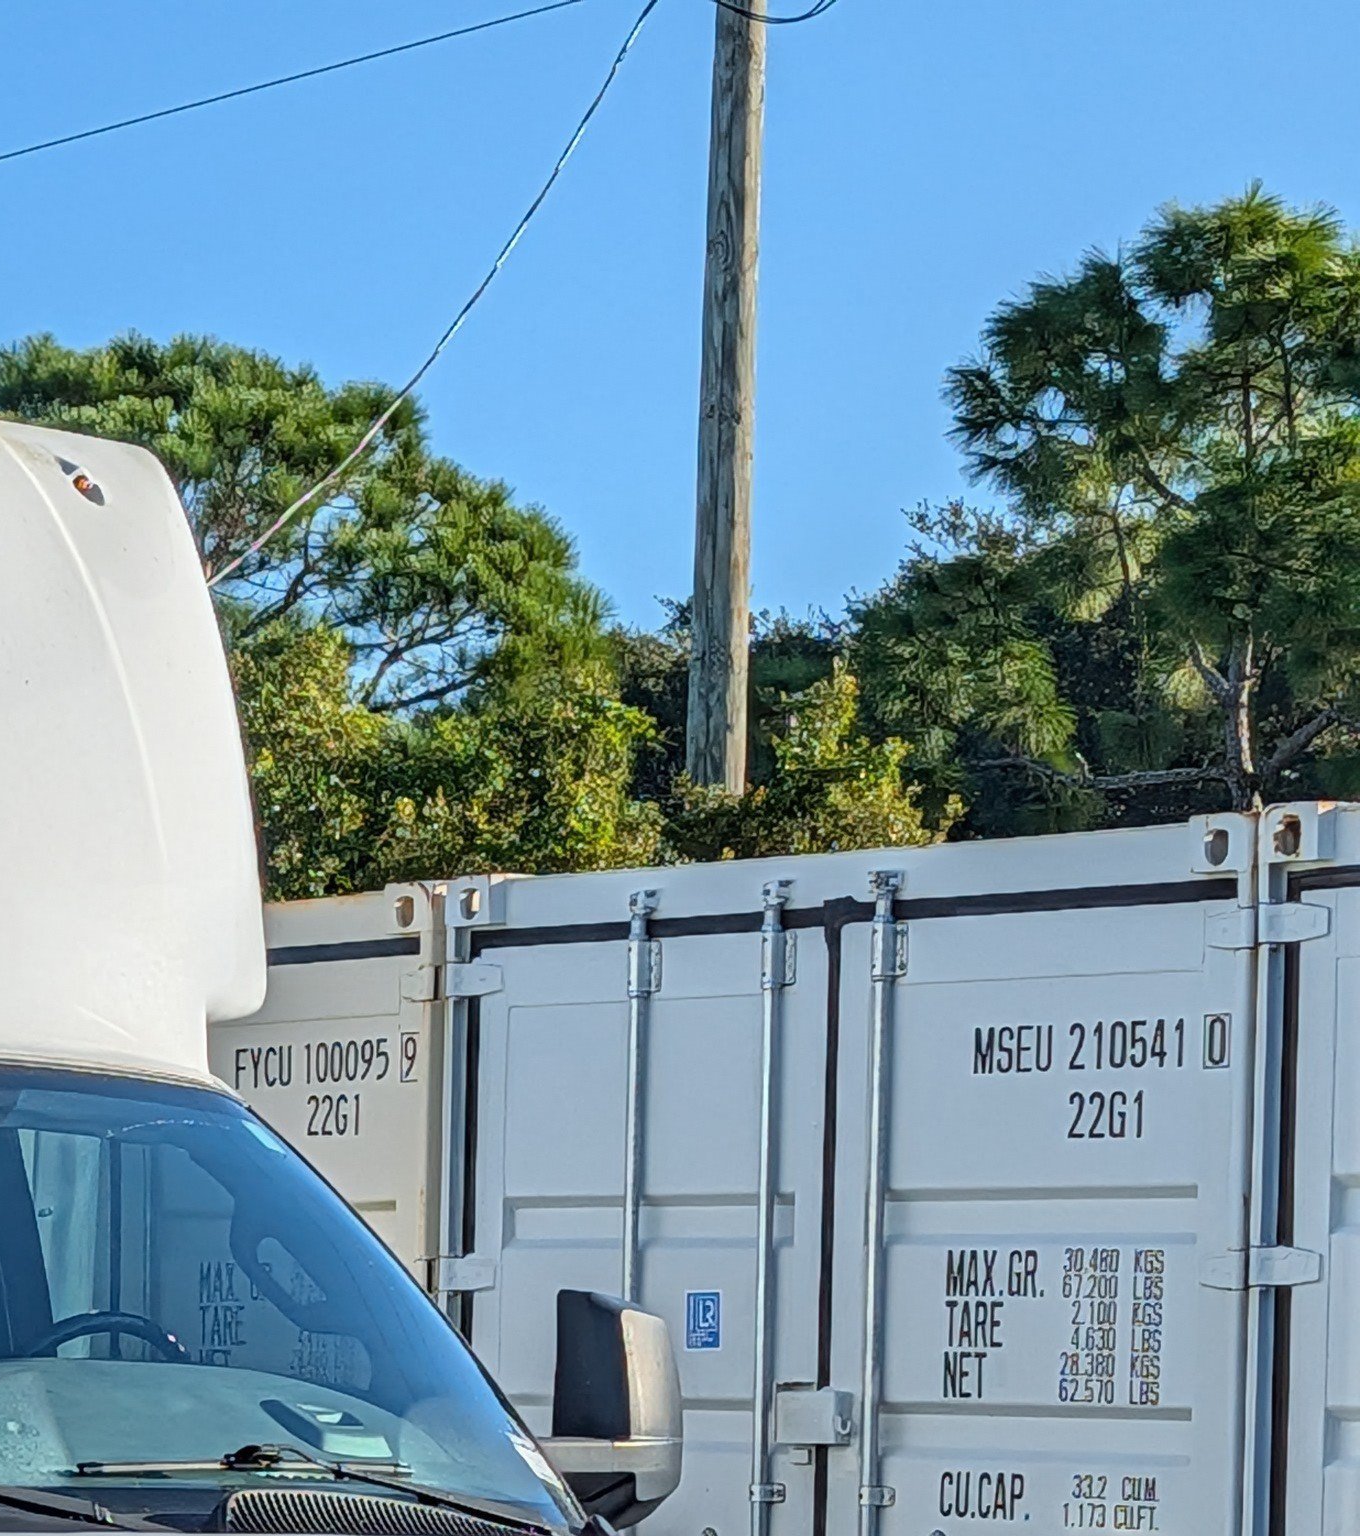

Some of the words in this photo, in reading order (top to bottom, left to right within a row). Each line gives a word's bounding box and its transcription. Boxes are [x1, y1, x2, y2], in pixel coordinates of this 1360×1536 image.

[235, 1044, 292, 1090] FYCU
[305, 1037, 390, 1085] 100095
[973, 1024, 1053, 1075] MSEU
[1068, 1018, 1185, 1070] 210541
[306, 1093, 361, 1136] 22G1
[1067, 1090, 1144, 1139] 22G1
[1133, 1247, 1165, 1274] KGS
[1132, 1275, 1164, 1301] LBS
[945, 1300, 1004, 1348] TARE
[1131, 1301, 1164, 1328] KGS
[1130, 1327, 1163, 1353] LBS
[942, 1351, 987, 1399] NET
[1129, 1352, 1161, 1380] KGS
[1128, 1379, 1160, 1405] LBS
